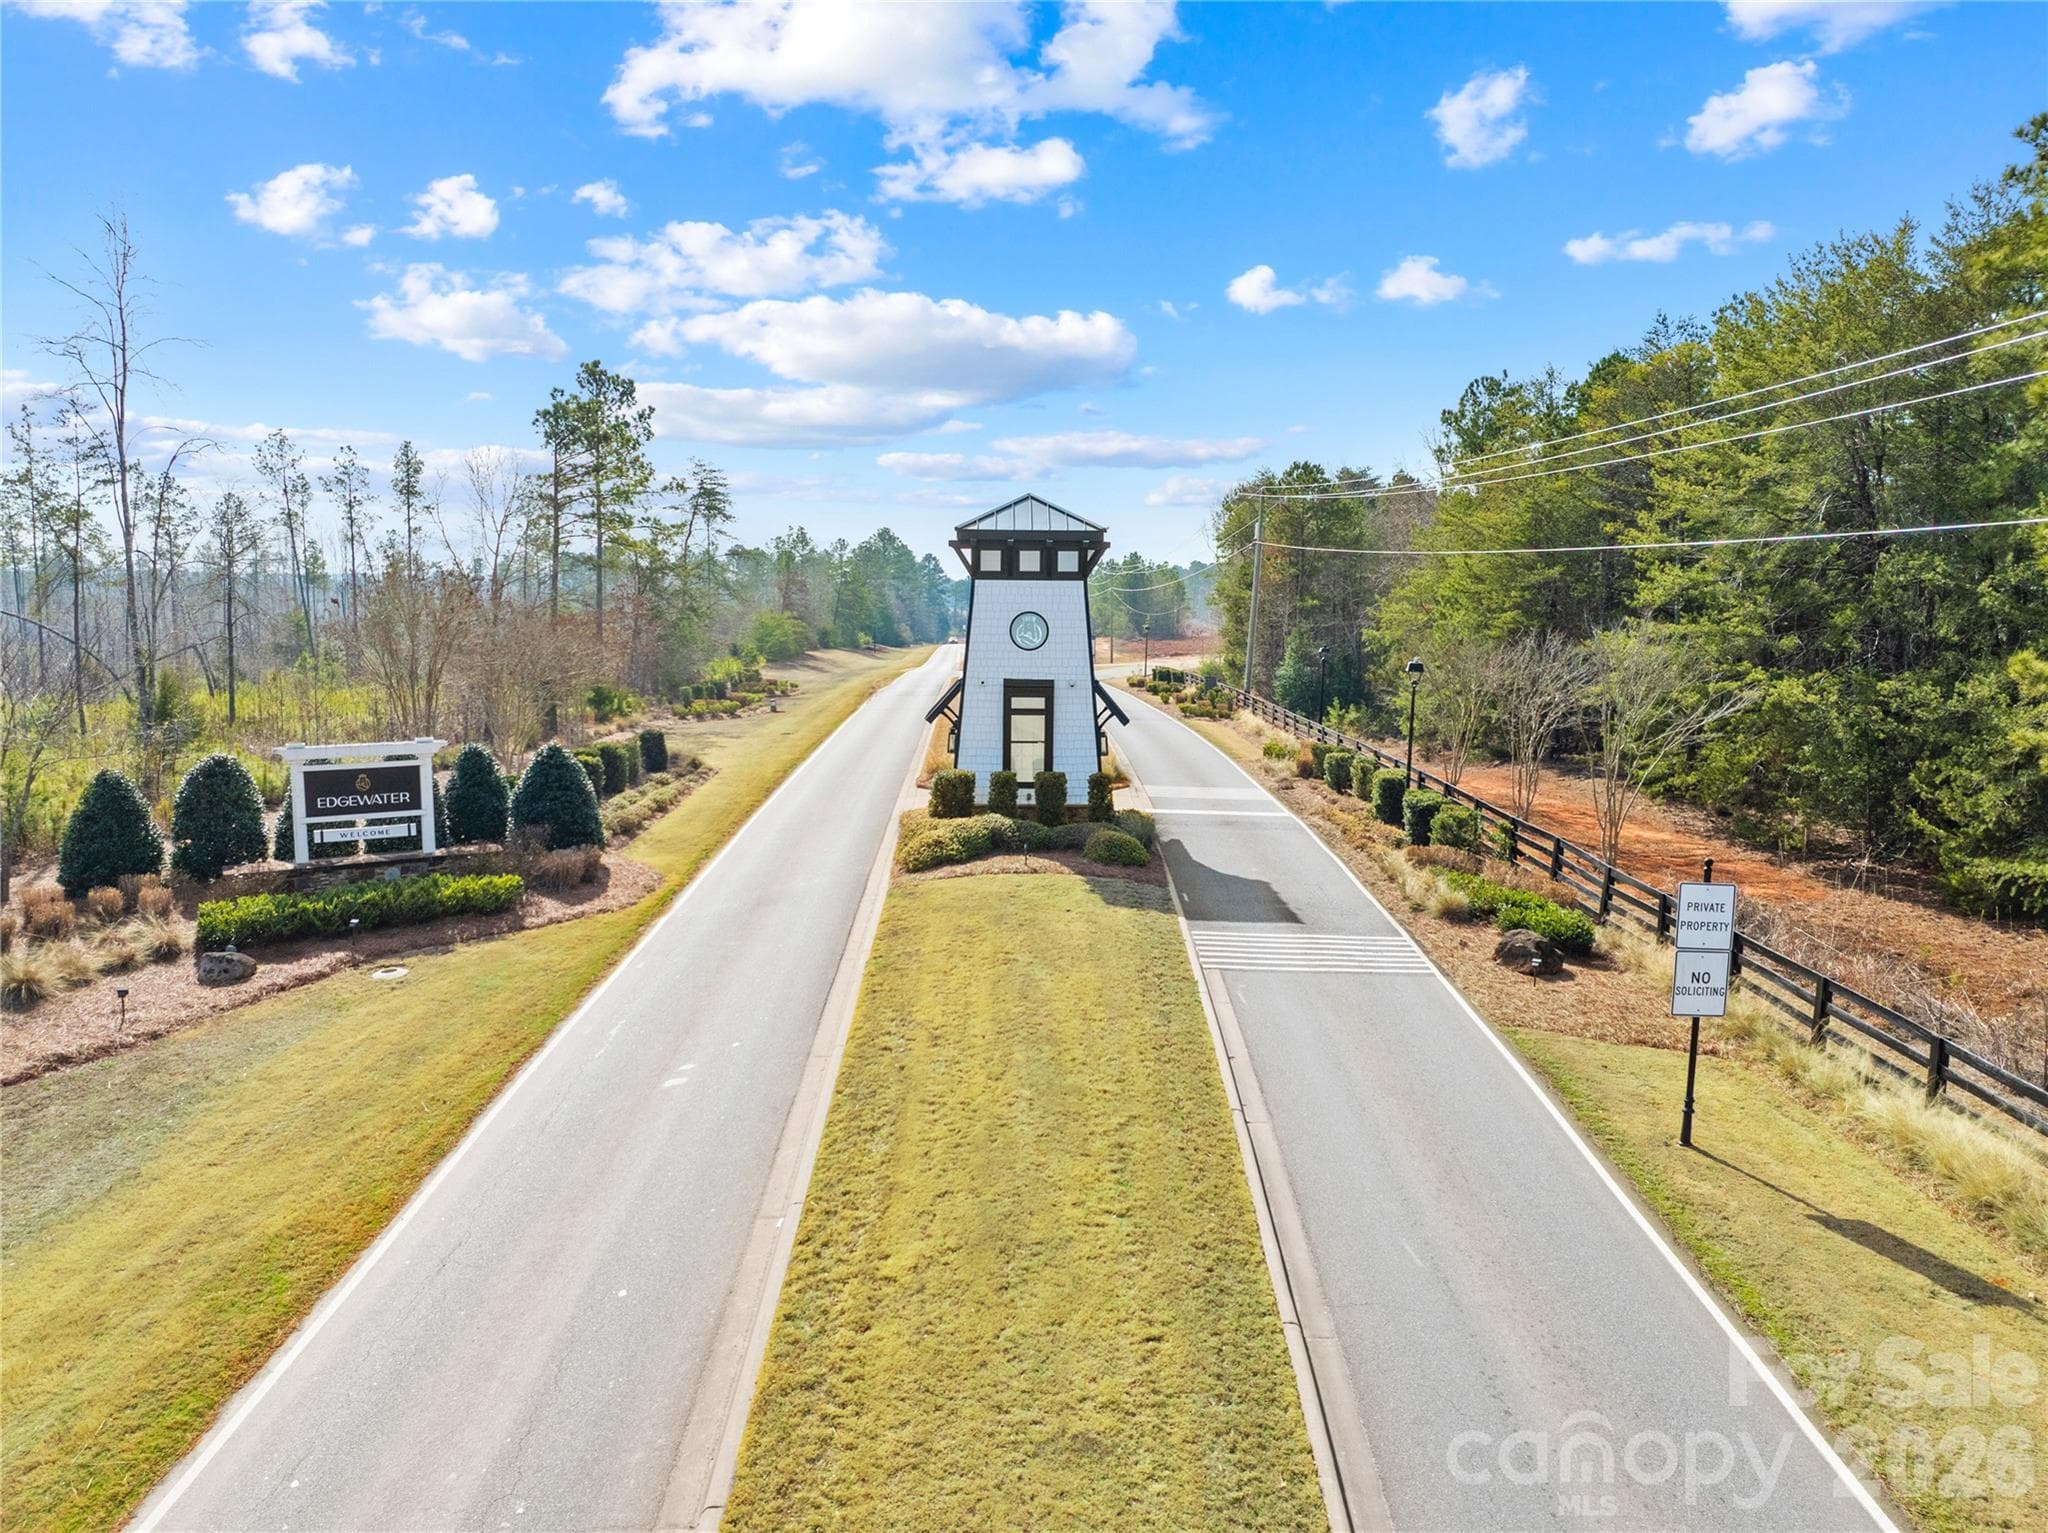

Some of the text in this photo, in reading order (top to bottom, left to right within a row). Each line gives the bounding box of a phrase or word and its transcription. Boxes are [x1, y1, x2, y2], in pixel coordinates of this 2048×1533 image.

[317, 791, 410, 808] EDGEWATER
[340, 829, 390, 838] WELCOME
[1687, 902, 1726, 913] PRIVATE
[1680, 921, 1730, 932] PROPERTY
[1691, 971, 1711, 984] NO
[1675, 986, 1725, 997] SOLICITING
